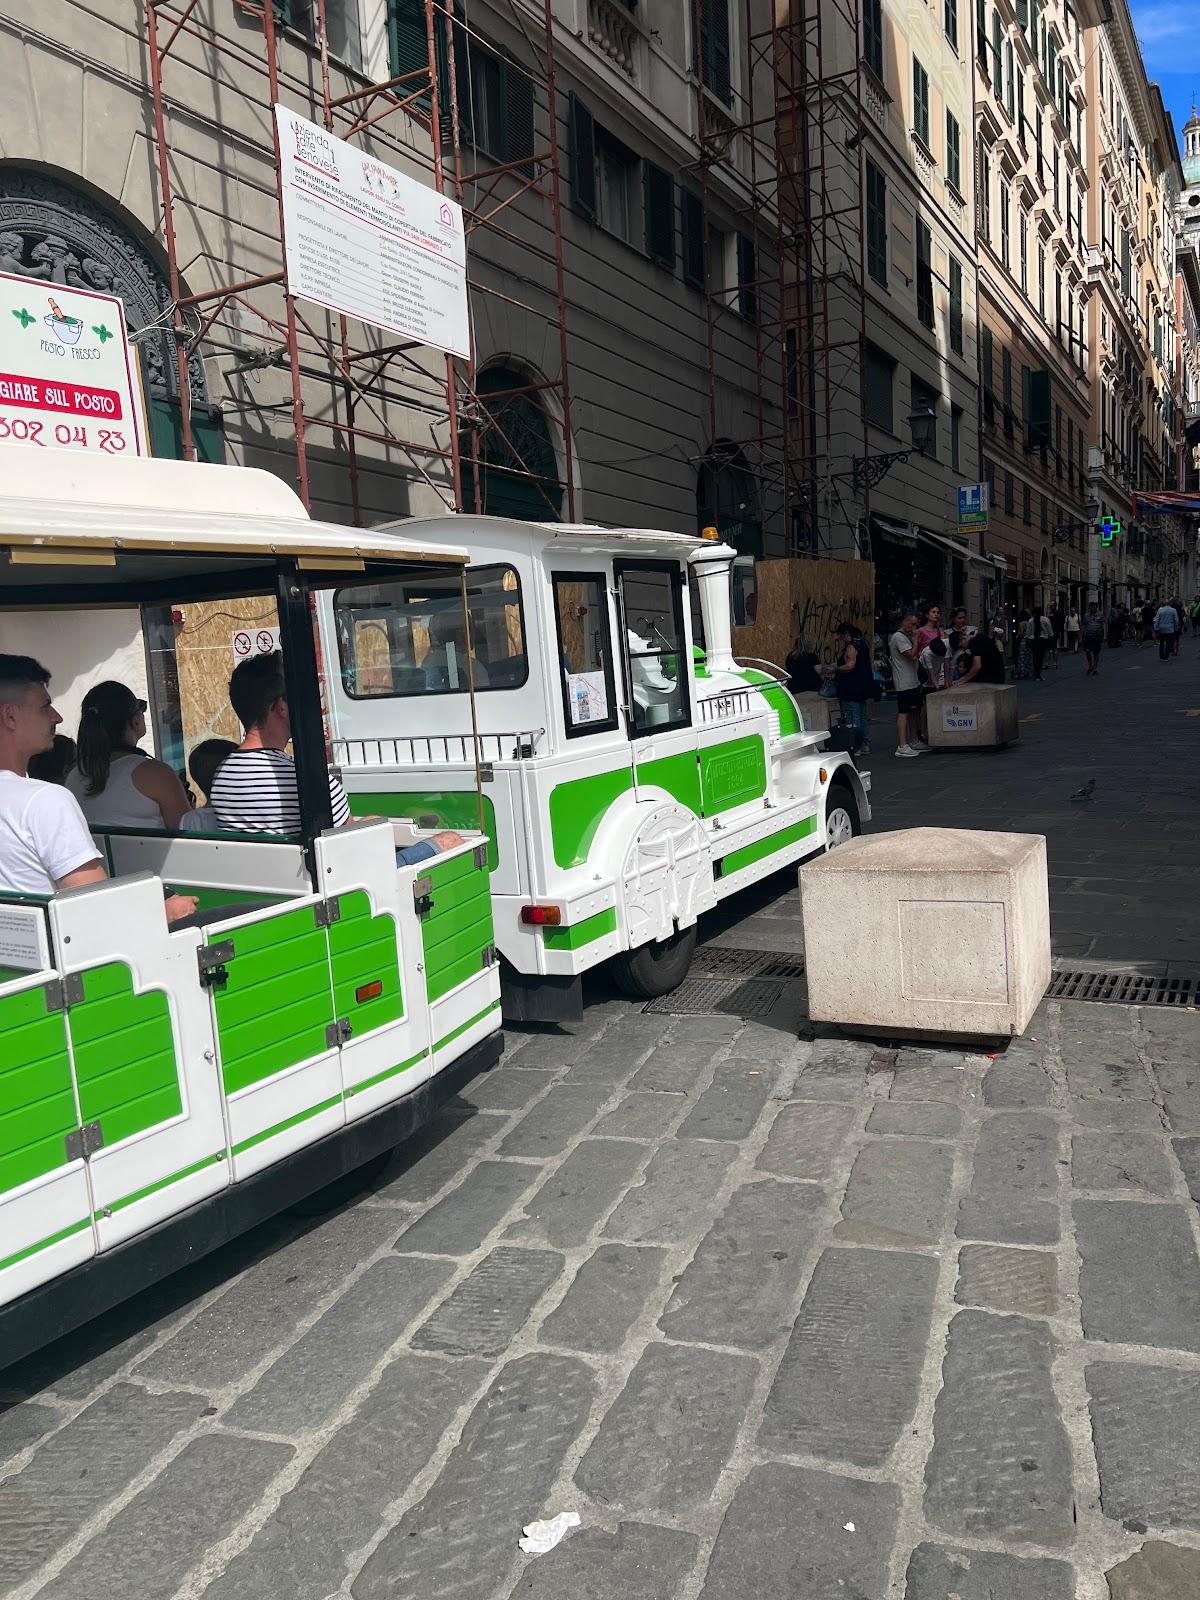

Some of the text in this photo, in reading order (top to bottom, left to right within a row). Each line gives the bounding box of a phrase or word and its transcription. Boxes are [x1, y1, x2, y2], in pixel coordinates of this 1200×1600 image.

[294, 122, 328, 151] Azienda
[296, 143, 338, 176] Genovese
[295, 166, 325, 187] INTERVENTO
[331, 185, 361, 206] RIFACIMENTO
[362, 201, 370, 210] DEL
[295, 174, 306, 186] CON
[308, 181, 339, 202] INSERIMENTO
[346, 200, 367, 217] ELEMENTI
[368, 212, 402, 234] TERMOISOLANTI
[40, 339, 101, 360] PESTO FRESCO
[45, 388, 70, 407] SUL
[75, 393, 115, 413] POSTO
[55, 424, 88, 447] 04
[98, 429, 126, 454] 23
